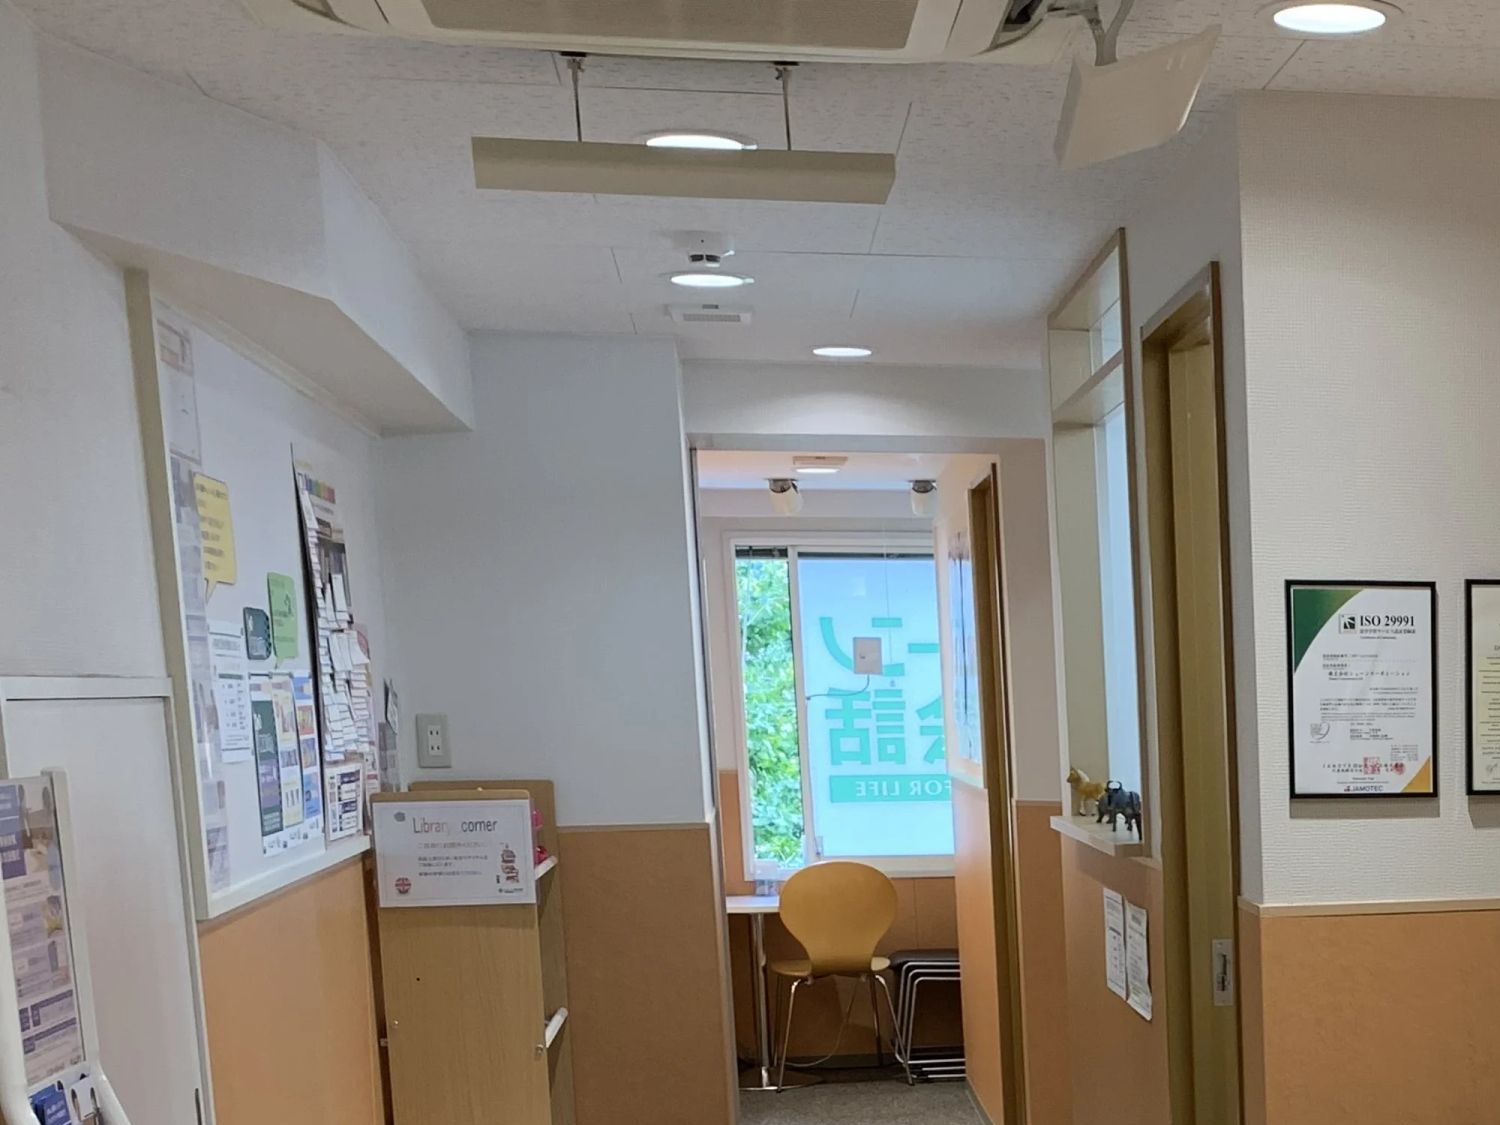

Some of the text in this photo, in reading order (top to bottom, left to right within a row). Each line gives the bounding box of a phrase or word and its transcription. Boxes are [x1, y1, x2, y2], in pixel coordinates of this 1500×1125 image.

[1360, 615, 1415, 627] ISO 29991
[460, 819, 498, 834] corner
